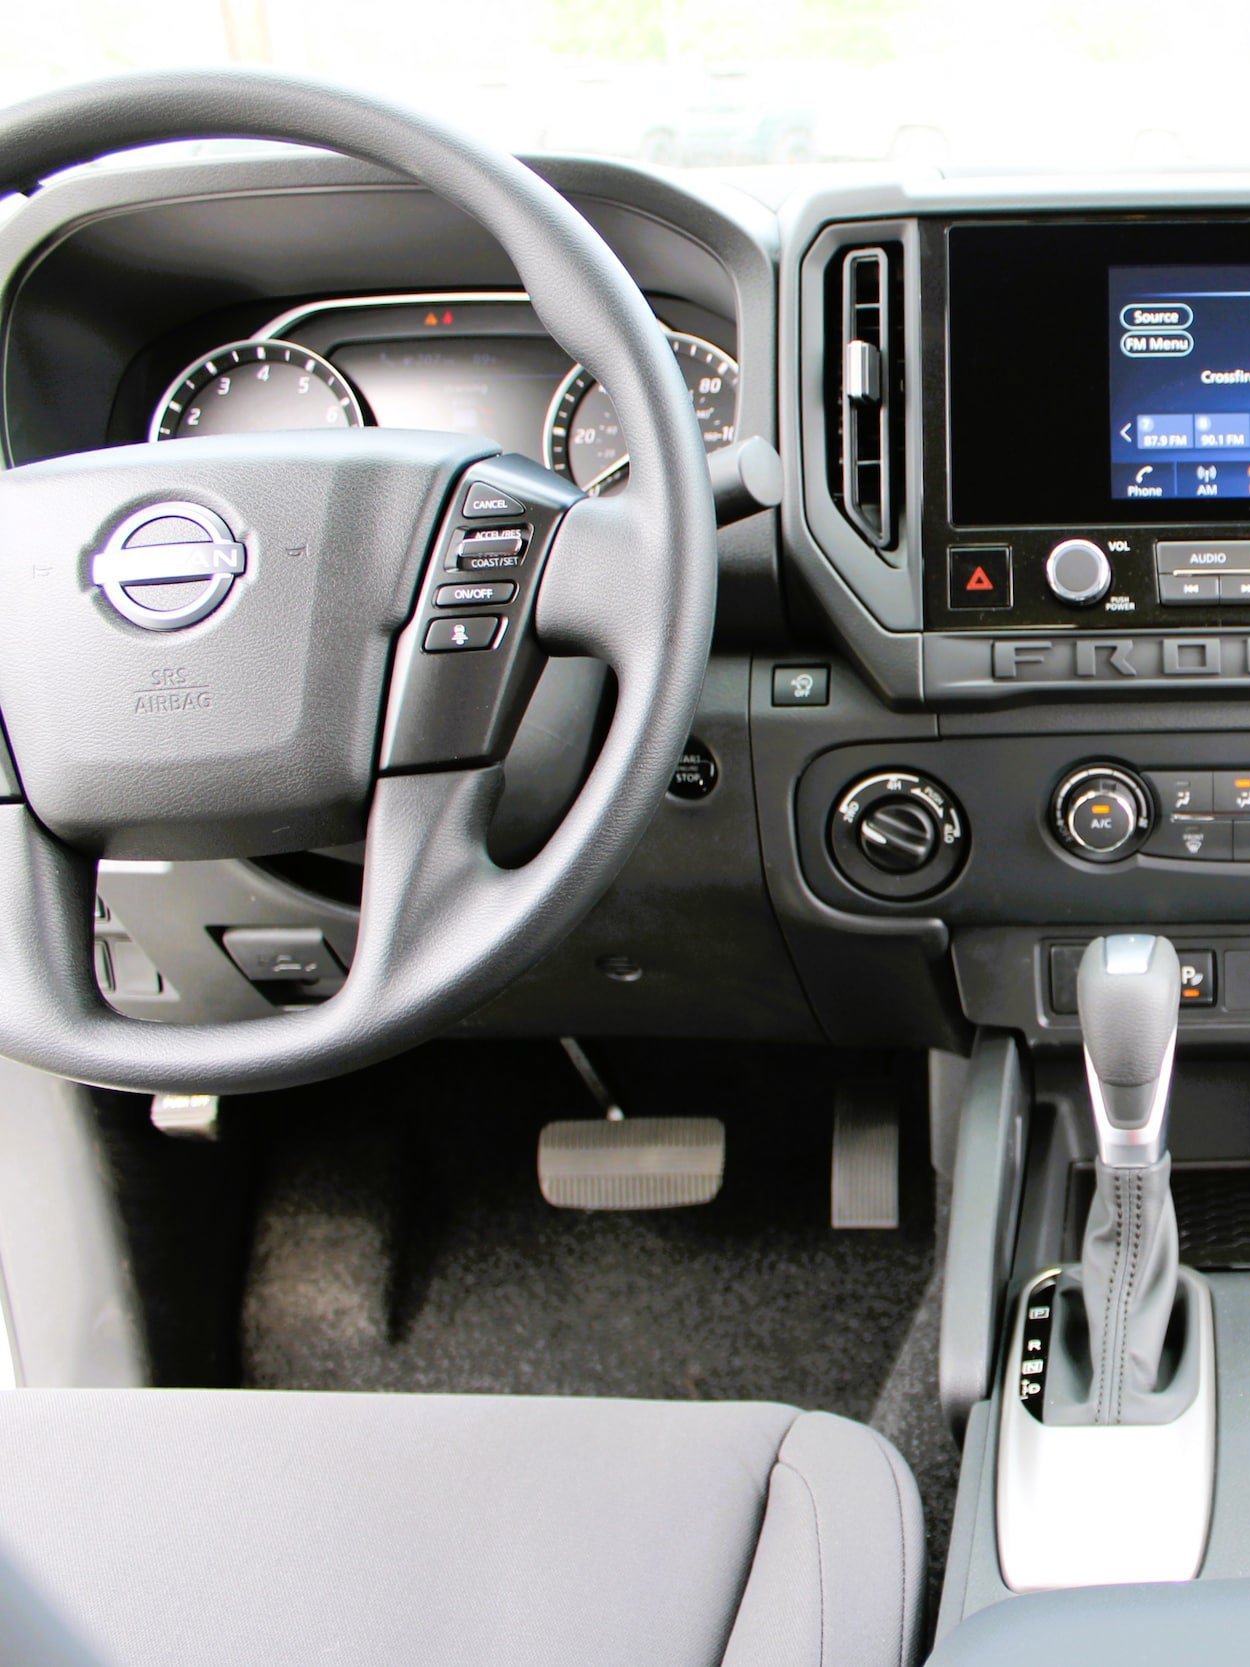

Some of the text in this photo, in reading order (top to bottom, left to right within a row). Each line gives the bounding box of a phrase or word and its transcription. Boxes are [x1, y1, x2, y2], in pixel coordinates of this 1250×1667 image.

[1133, 310, 1179, 324] Source
[1125, 337, 1189, 351] FM Menu
[256, 364, 270, 382] 4
[217, 377, 231, 395] 3
[298, 376, 310, 394] 5
[698, 377, 722, 394] 80
[187, 408, 201, 426] 2
[325, 405, 338, 423] 6
[574, 428, 597, 444] 20
[1169, 435, 1188, 446] FM
[1226, 434, 1245, 445] FM
[1127, 485, 1163, 497] Phone
[1196, 484, 1218, 496] AM
[473, 499, 508, 510] CANCEL
[1107, 540, 1131, 552] VOL
[471, 557, 519, 568] COAST/SET
[1189, 553, 1227, 564] AUDIO
[454, 588, 494, 599] ON/OFF
[1105, 602, 1136, 611] POWER
[150, 667, 188, 686] SRS
[134, 691, 213, 715] AIRBAG
[675, 772, 701, 783] STOP
[1090, 819, 1113, 829] A/C
